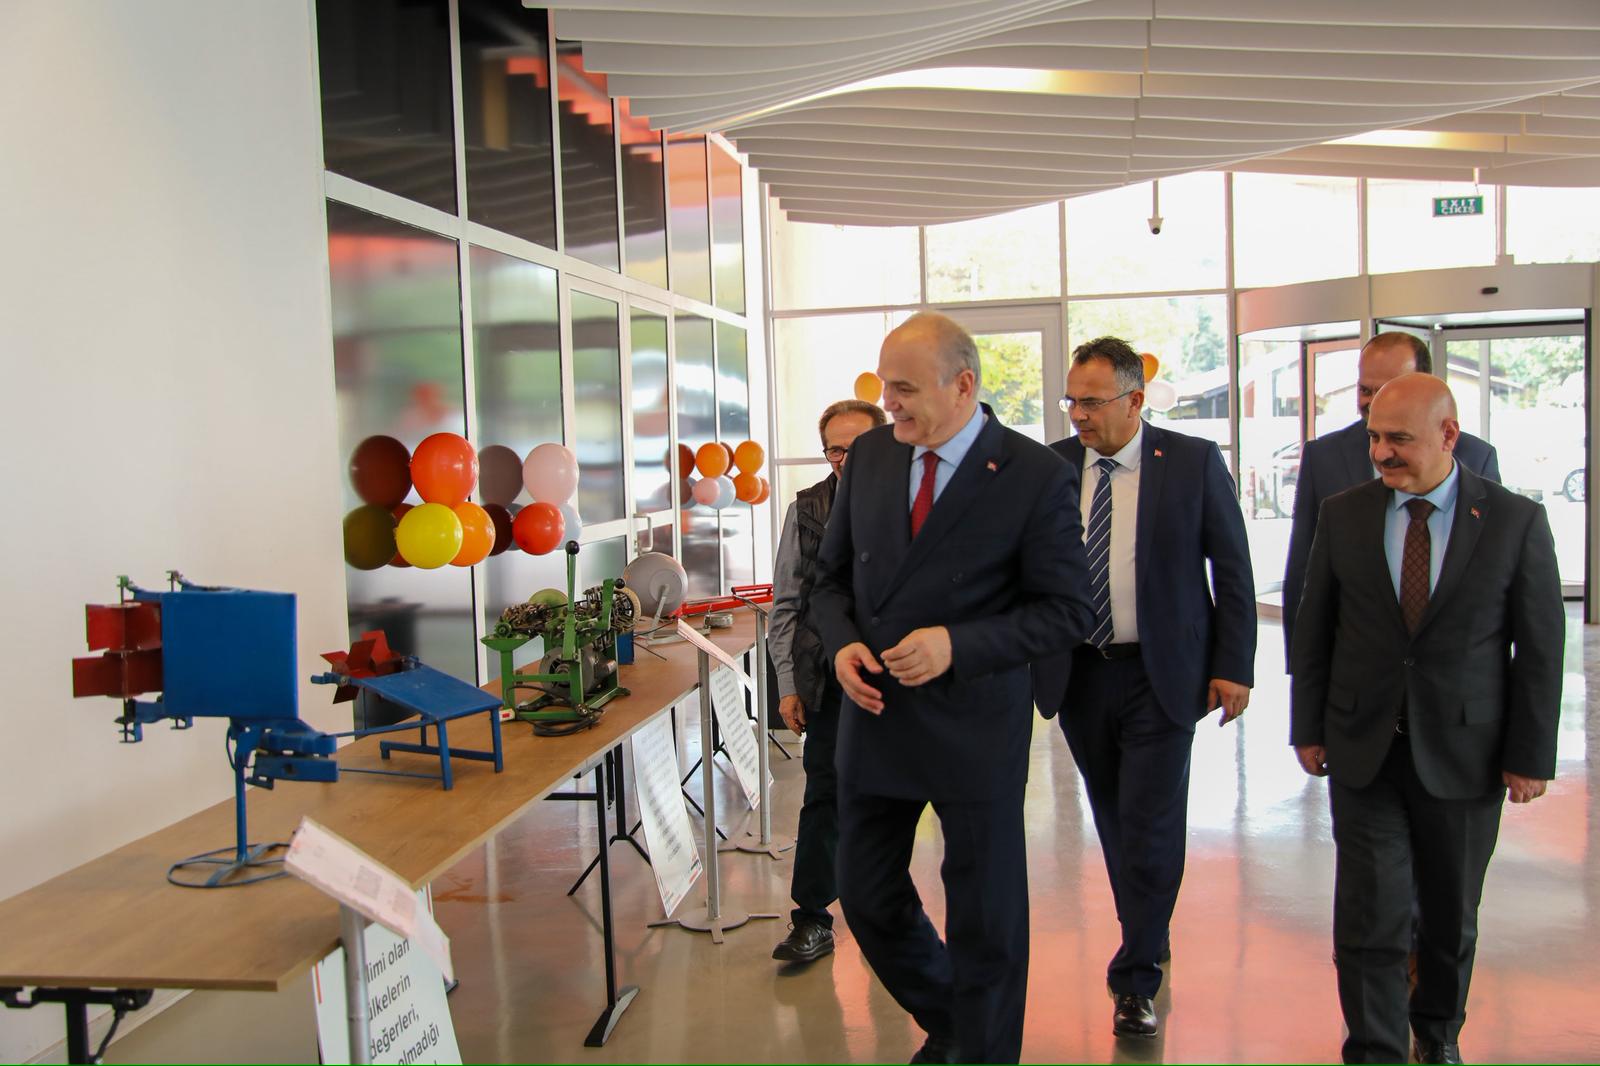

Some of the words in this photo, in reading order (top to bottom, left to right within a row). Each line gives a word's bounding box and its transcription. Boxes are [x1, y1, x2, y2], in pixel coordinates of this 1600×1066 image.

[1441, 199, 1475, 207] EXIT
[366, 952, 387, 983] limi
[388, 938, 410, 966] olan
